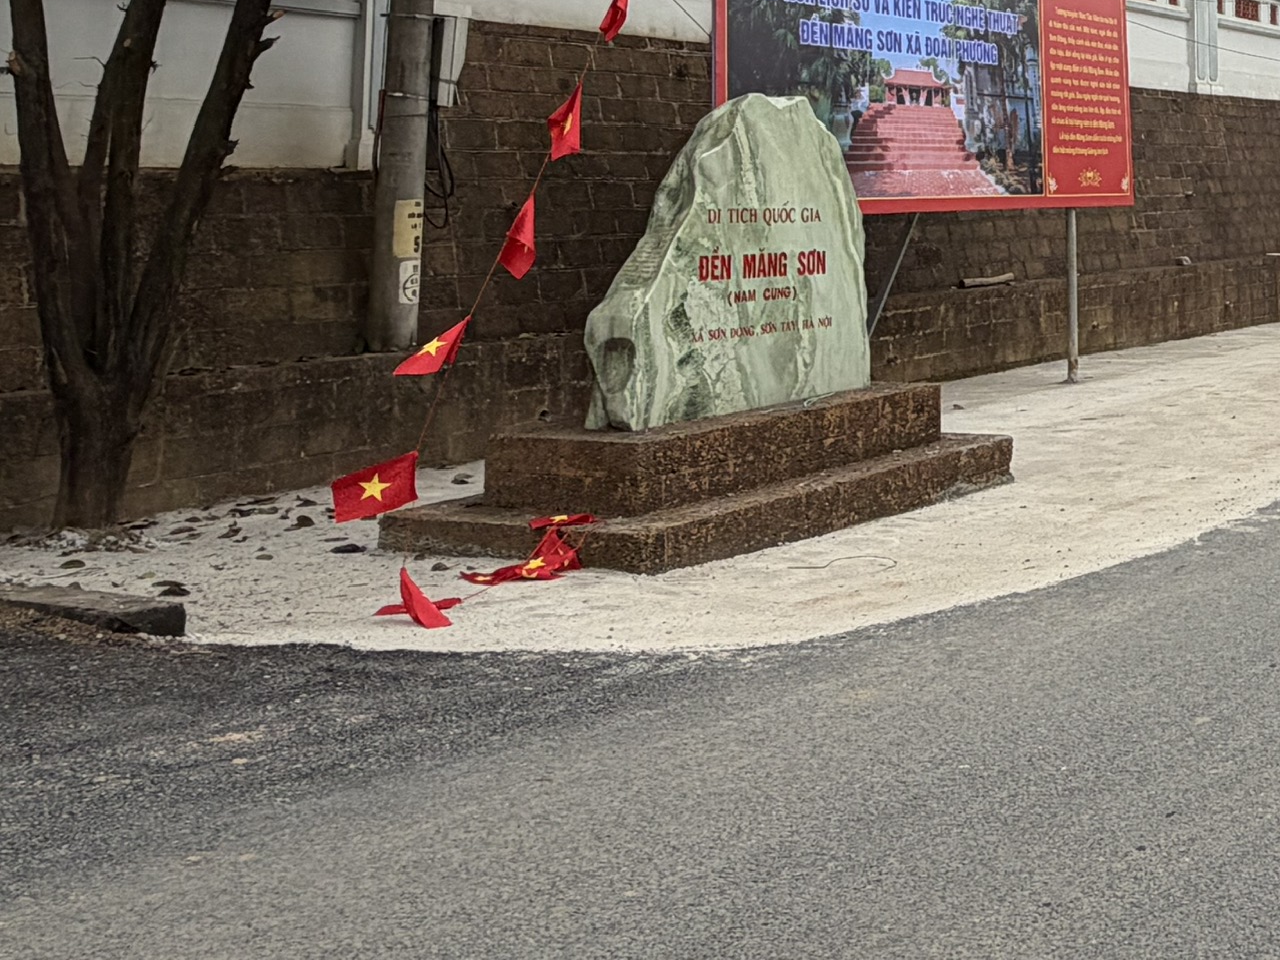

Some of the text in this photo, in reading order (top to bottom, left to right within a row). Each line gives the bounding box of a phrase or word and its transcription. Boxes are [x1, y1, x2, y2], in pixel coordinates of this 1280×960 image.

[955, 3, 985, 35] NGHỆ
[987, 7, 1019, 38] THUẬT
[877, 28, 902, 54] SƠN
[906, 30, 922, 56] XÃ
[708, 200, 822, 226] DI TÍCH QUỐC GIA
[698, 246, 826, 282] ĐỀN MĂNG SƠN
[727, 286, 797, 307] (NAM CUNG)
[708, 328, 727, 340] SƠN
[760, 321, 777, 335] SƠN
[818, 315, 832, 330] NỘI
